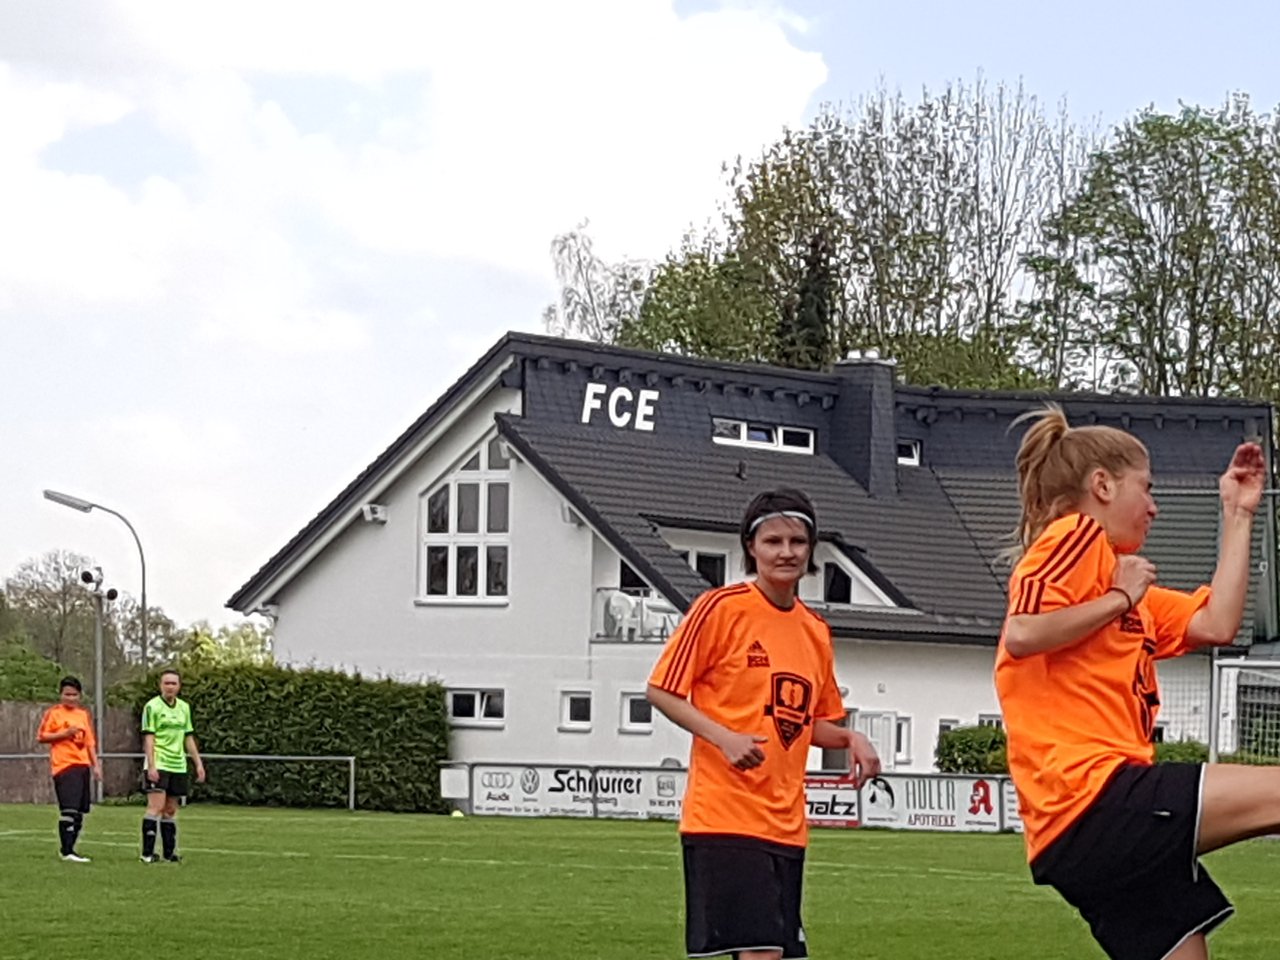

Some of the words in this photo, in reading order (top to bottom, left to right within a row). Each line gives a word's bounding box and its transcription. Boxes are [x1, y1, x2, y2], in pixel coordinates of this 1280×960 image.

[581, 382, 660, 431] FCE
[905, 778, 956, 811] ADLER
[907, 813, 956, 828] APOTHEKE
